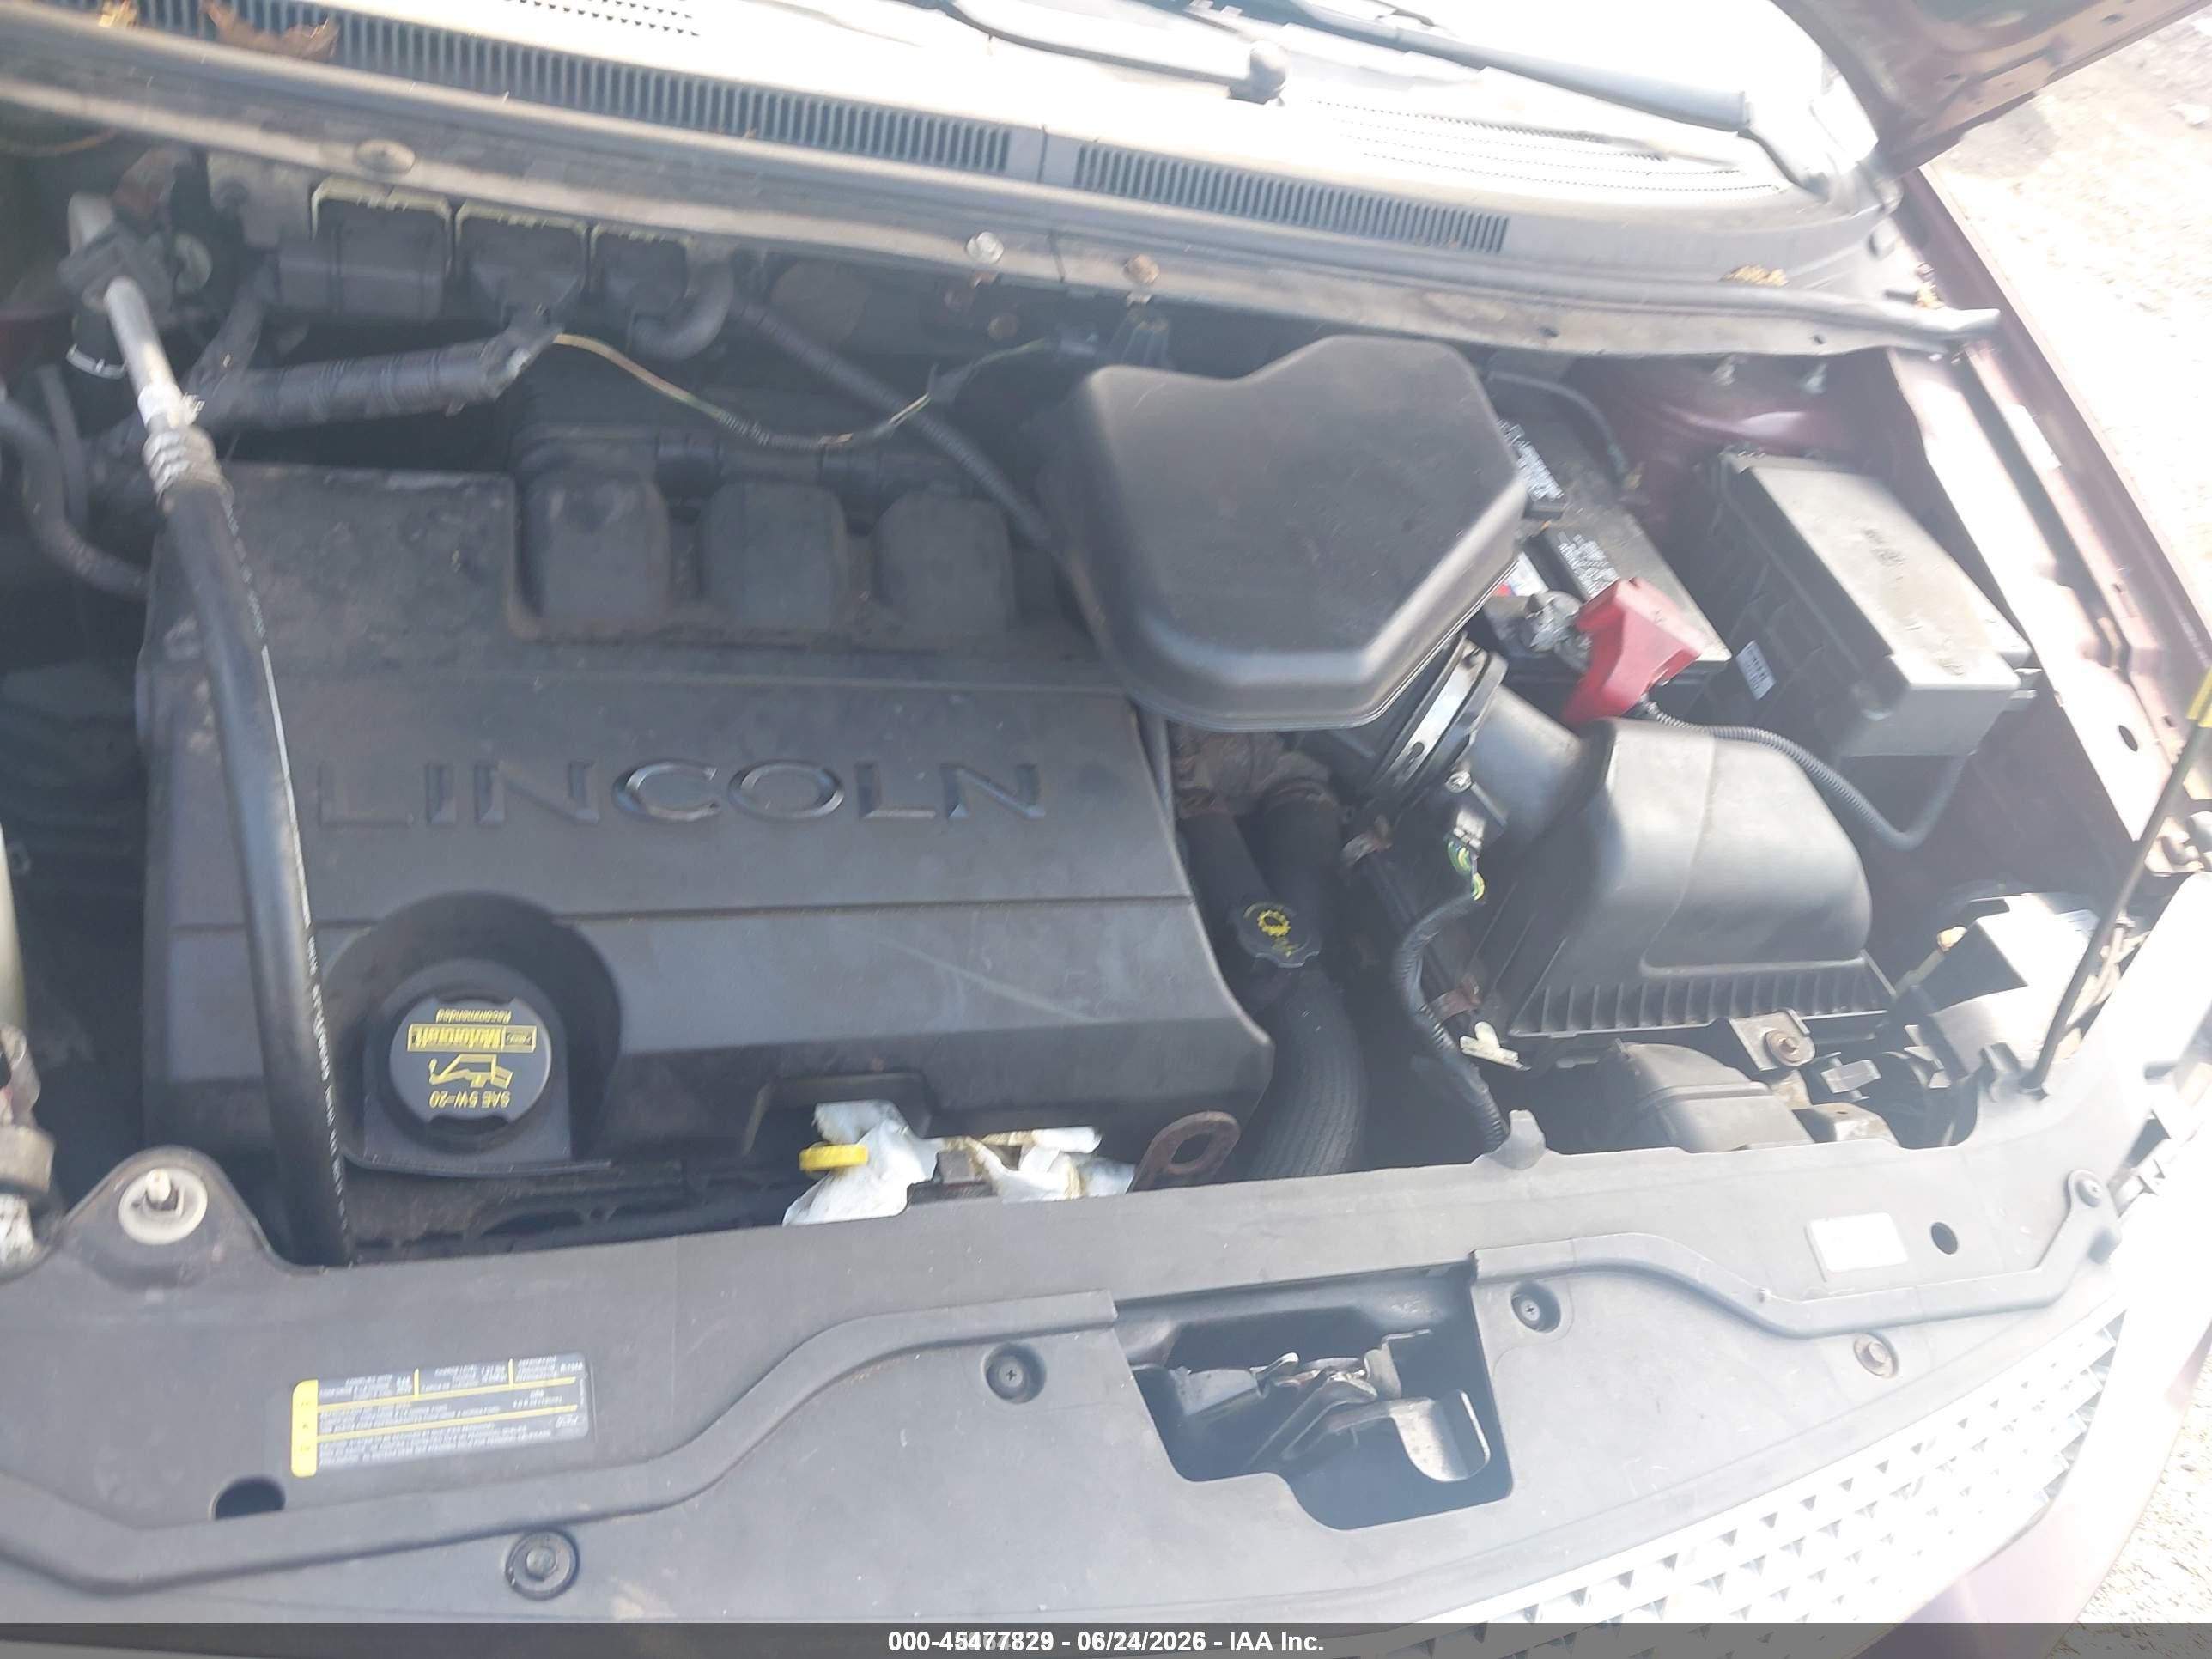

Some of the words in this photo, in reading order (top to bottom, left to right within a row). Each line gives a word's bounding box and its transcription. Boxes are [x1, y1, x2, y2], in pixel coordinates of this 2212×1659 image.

[319, 760, 1046, 823] LINCOLN
[435, 1009, 512, 1024] Recommended
[414, 1027, 502, 1049] Motorcraft
[429, 1091, 478, 1109] 5W-20
[482, 1091, 511, 1109] SAE
